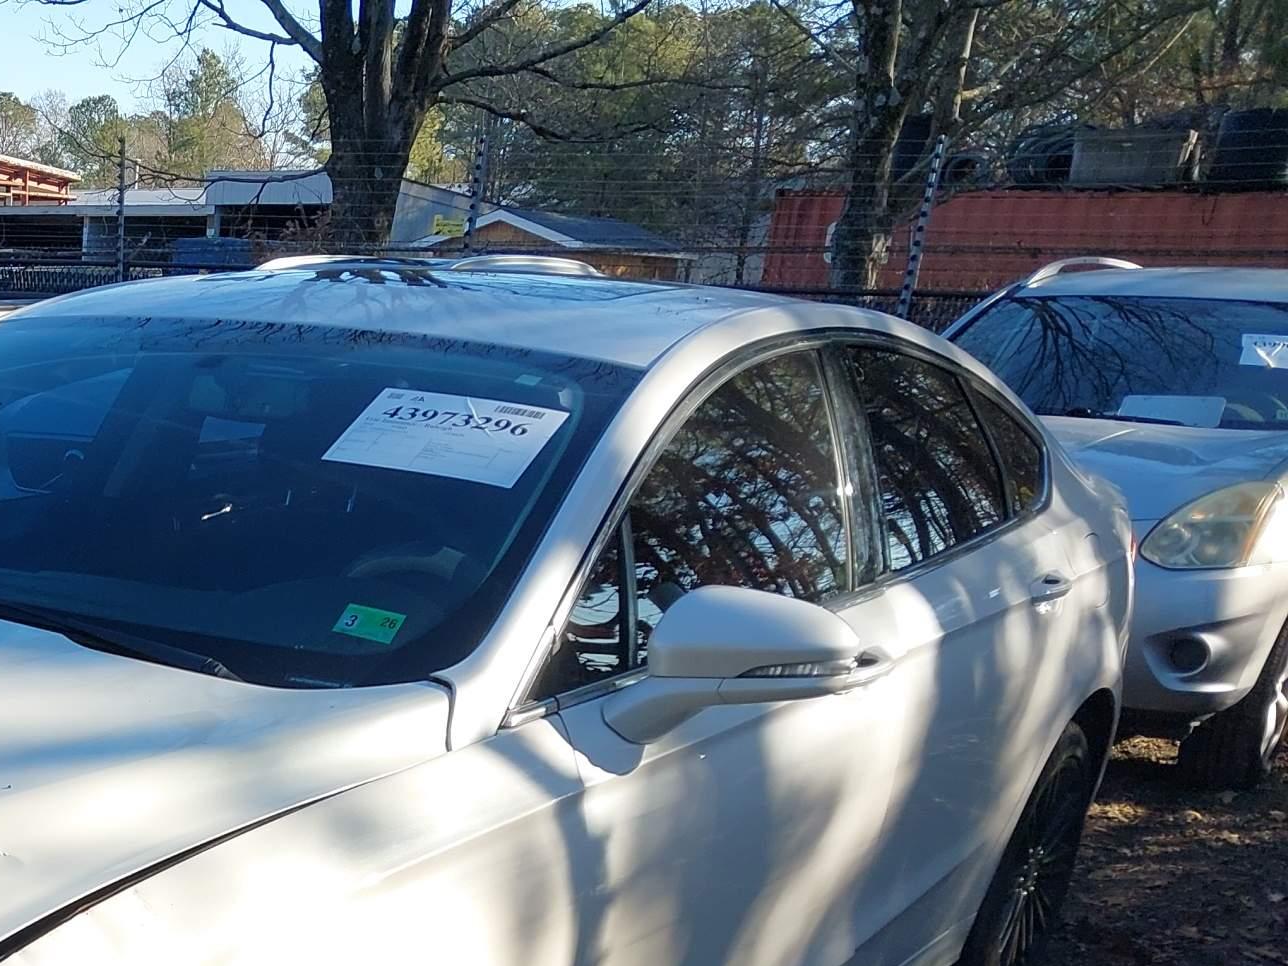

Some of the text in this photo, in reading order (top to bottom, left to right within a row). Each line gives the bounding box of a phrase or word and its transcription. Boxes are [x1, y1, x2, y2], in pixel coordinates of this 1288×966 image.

[382, 405, 532, 436] 43973296
[344, 614, 399, 629] 3 26
